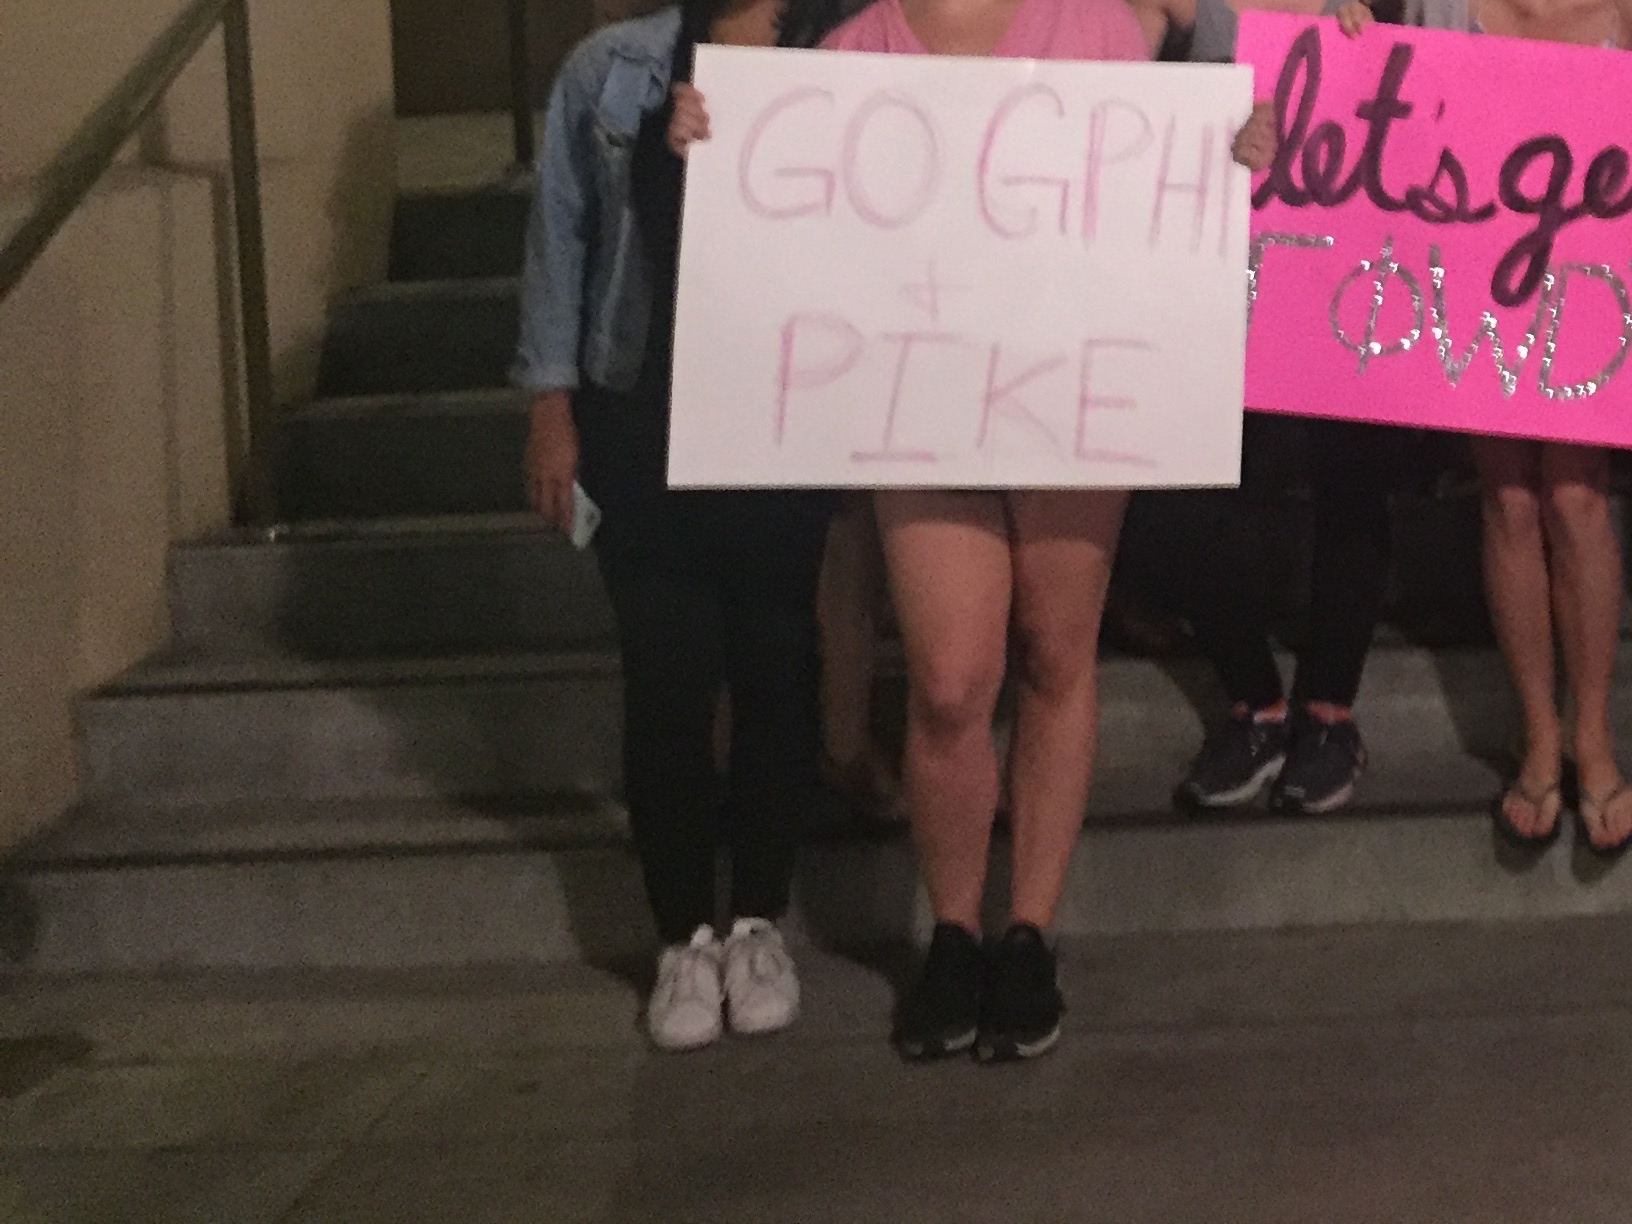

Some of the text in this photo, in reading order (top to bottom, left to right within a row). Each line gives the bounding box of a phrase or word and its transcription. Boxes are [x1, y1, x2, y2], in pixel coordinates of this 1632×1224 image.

[736, 82, 1236, 258] GO GPHI
[1250, 25, 1497, 224] let's
[773, 311, 1160, 467] PIKE
